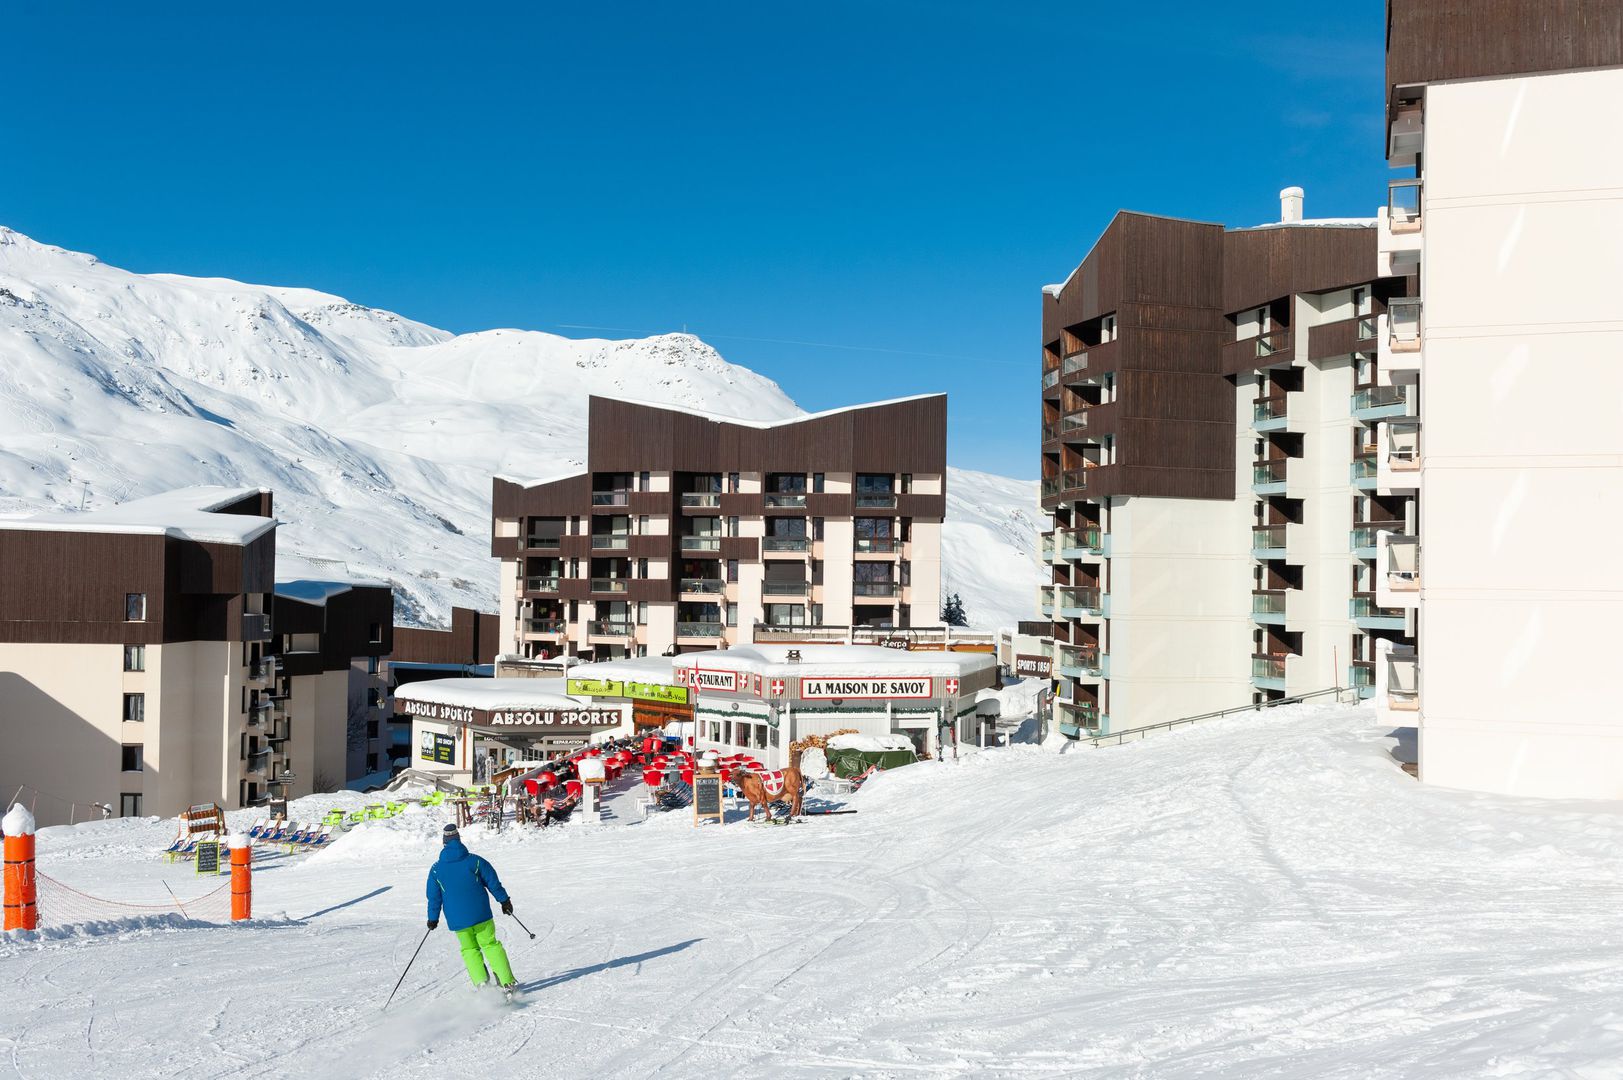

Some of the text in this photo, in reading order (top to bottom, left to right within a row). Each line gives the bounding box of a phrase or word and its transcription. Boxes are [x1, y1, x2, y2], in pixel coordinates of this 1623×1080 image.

[880, 640, 907, 648] sherpa
[1017, 659, 1050, 673] SPORTS 1850
[690, 673, 733, 687] RSTAURANT
[808, 682, 925, 694] LA MAISON DE SAVOY
[405, 701, 473, 722] ABSOLU SPORTS
[491, 712, 618, 725] ABSOLU SPORTS
